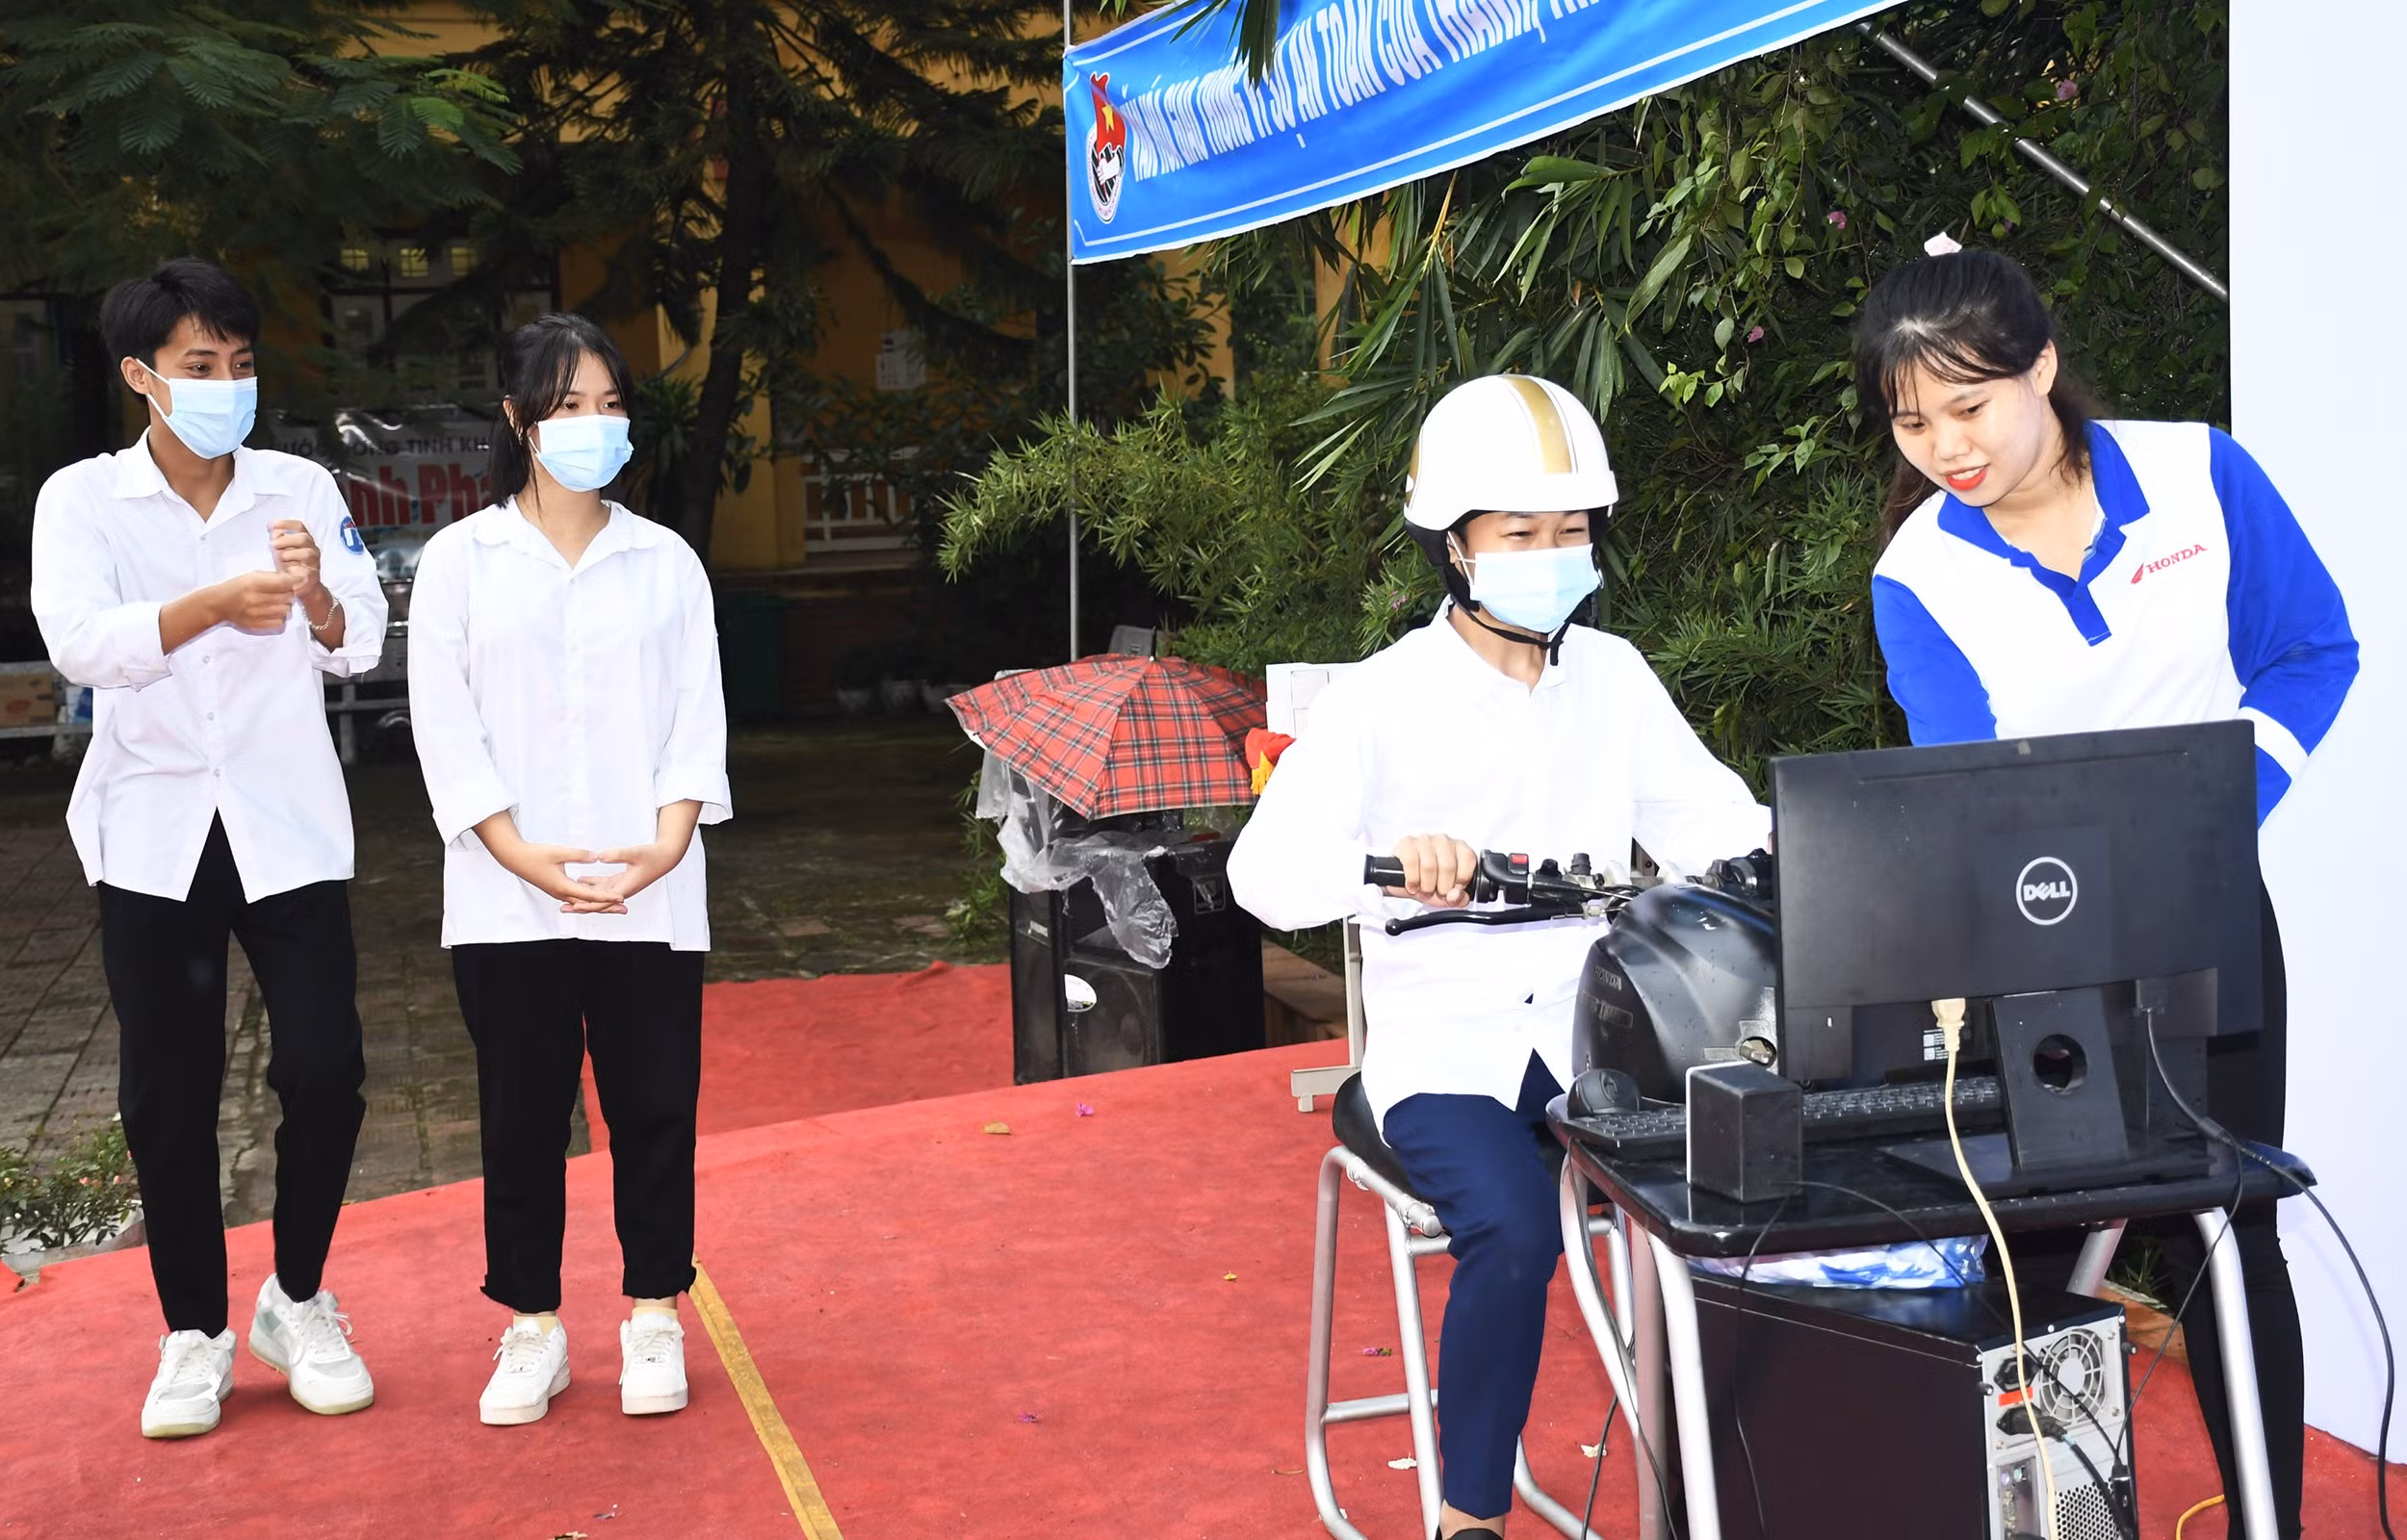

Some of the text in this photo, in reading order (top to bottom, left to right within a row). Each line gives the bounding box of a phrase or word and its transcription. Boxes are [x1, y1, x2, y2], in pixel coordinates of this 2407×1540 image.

[1288, 15, 1329, 123] AN
[2146, 544, 2208, 574] HONDA
[2023, 881, 2071, 902] DELL
[1594, 965, 1622, 991] HONDA
